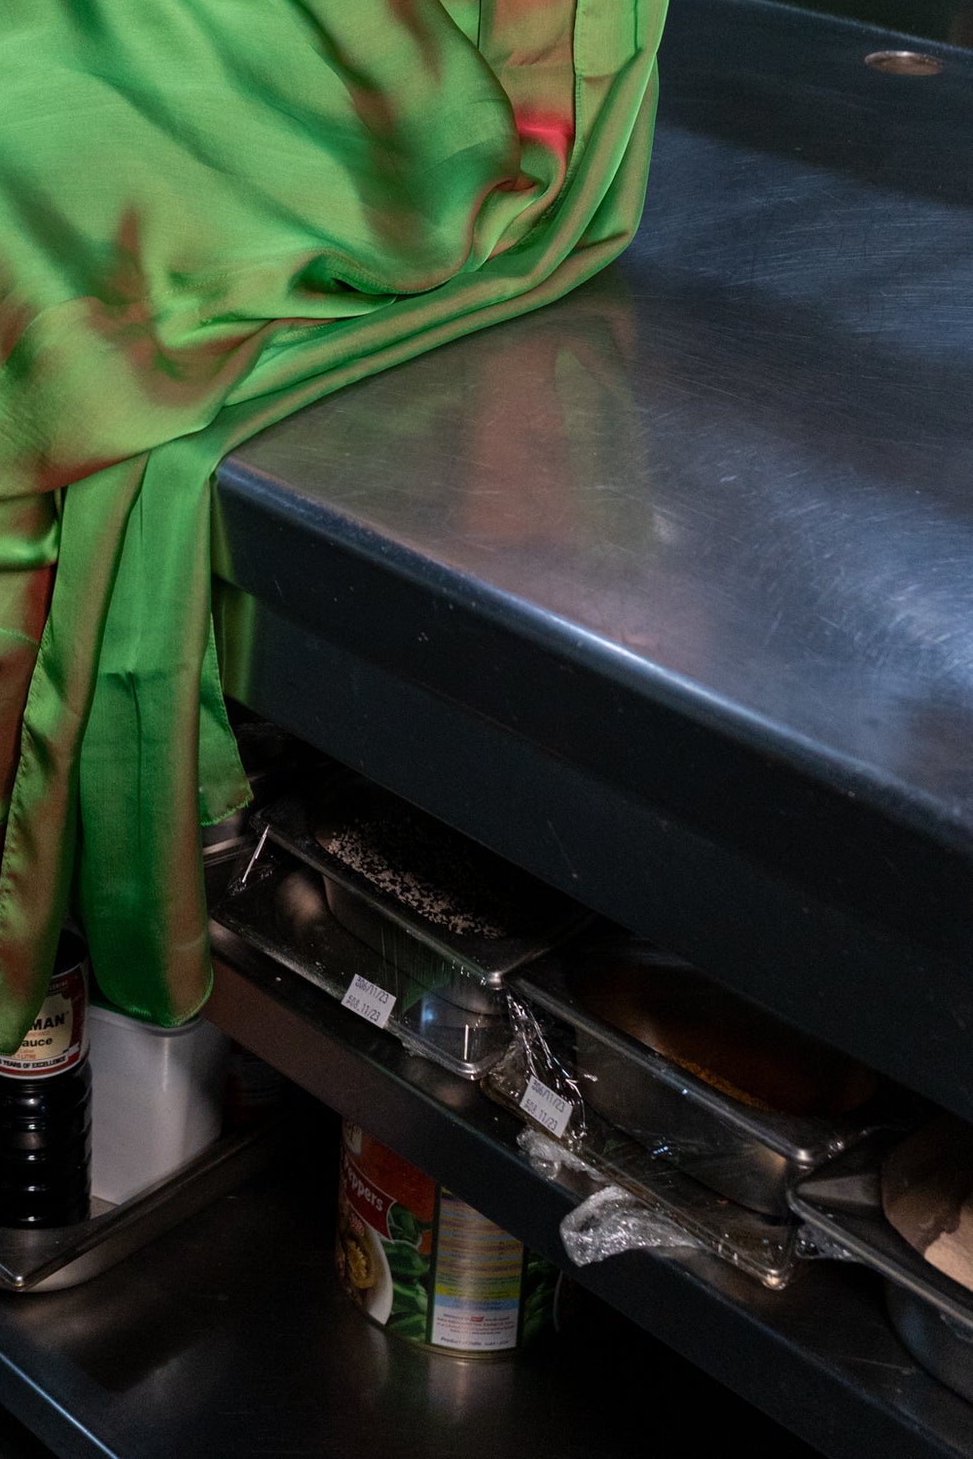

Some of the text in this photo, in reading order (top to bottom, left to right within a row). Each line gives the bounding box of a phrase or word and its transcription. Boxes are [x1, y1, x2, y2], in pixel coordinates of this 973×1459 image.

[31, 1012, 65, 1030] MAN
[22, 1037, 53, 1047] auce
[3, 1059, 21, 1069] YEARS
[32, 1056, 66, 1069] EXCELLENCE
